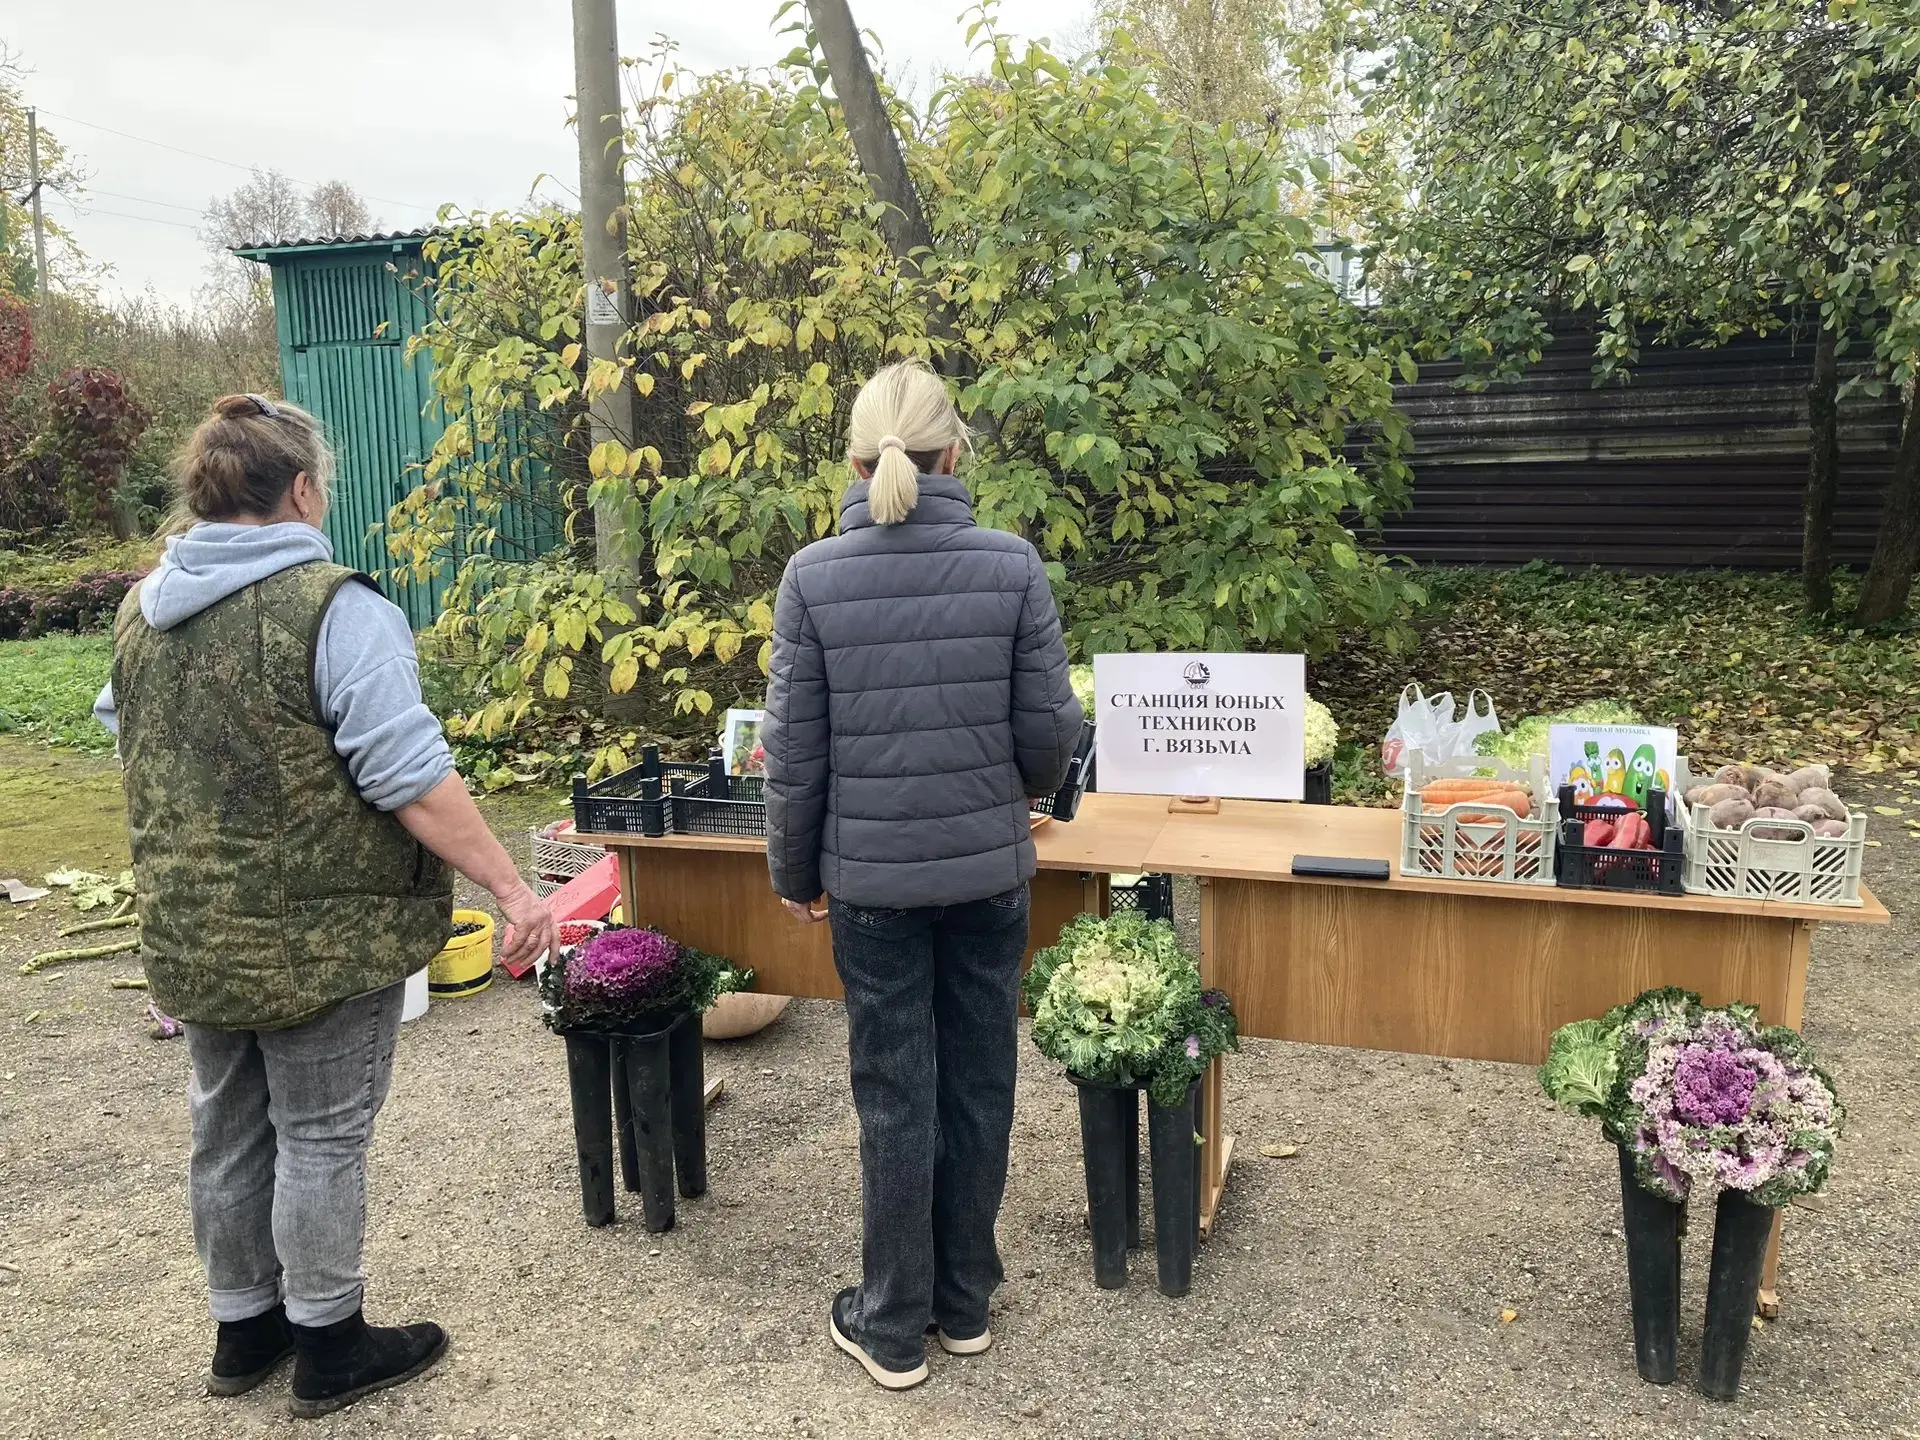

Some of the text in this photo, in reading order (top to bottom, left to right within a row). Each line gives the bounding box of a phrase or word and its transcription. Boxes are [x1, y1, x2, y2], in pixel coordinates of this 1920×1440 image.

[1110, 693, 1285, 711] СТАНЦИЯ ЮНЫХ
[1138, 715, 1257, 732] ТЕХНИКОВ
[1143, 738, 1252, 755] Г. ВЯЗЬМА
